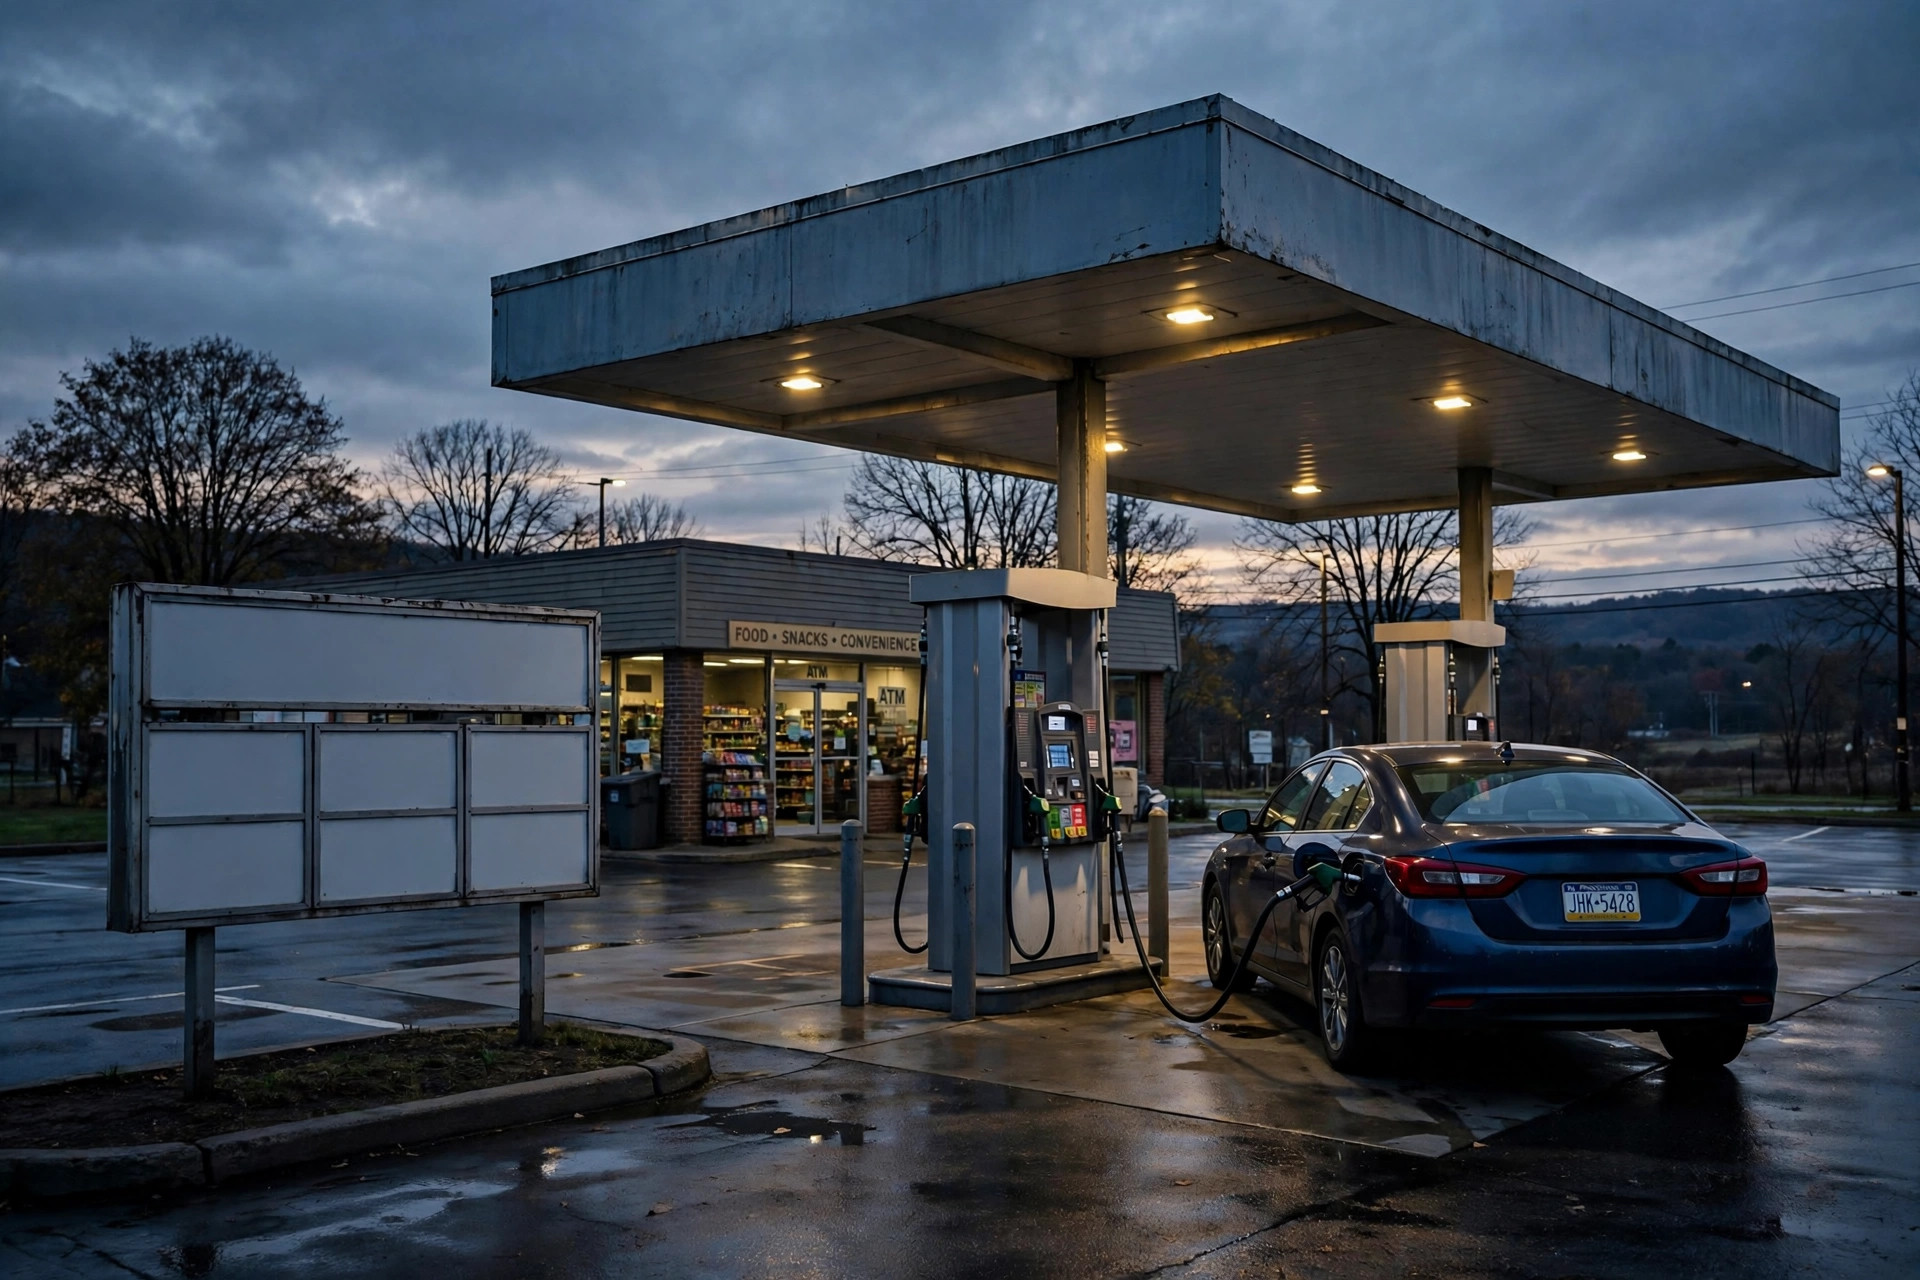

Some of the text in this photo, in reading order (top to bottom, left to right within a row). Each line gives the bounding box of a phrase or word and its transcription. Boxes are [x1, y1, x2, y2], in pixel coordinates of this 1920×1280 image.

[735, 627, 917, 652] FOOD SNACKS CONVENIENCE
[807, 665, 828, 678] ATM
[879, 688, 905, 704] ATM
